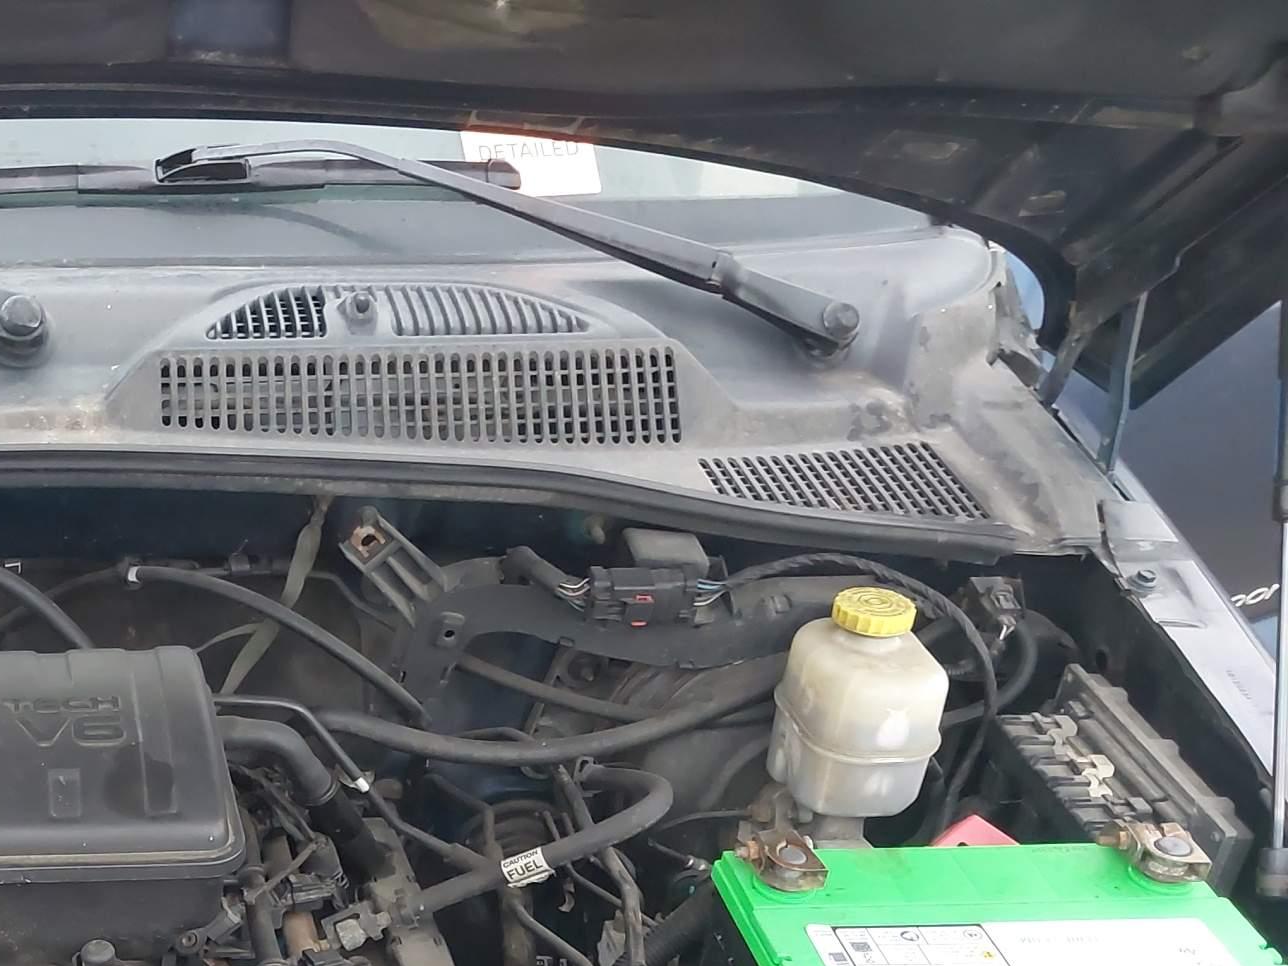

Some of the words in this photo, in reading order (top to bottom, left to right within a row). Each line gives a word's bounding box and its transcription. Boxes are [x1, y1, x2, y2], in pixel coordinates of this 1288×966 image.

[0, 695, 121, 714] TECH
[18, 714, 126, 748] V6
[502, 848, 539, 869] CAUTION
[506, 859, 544, 880] FUEL
